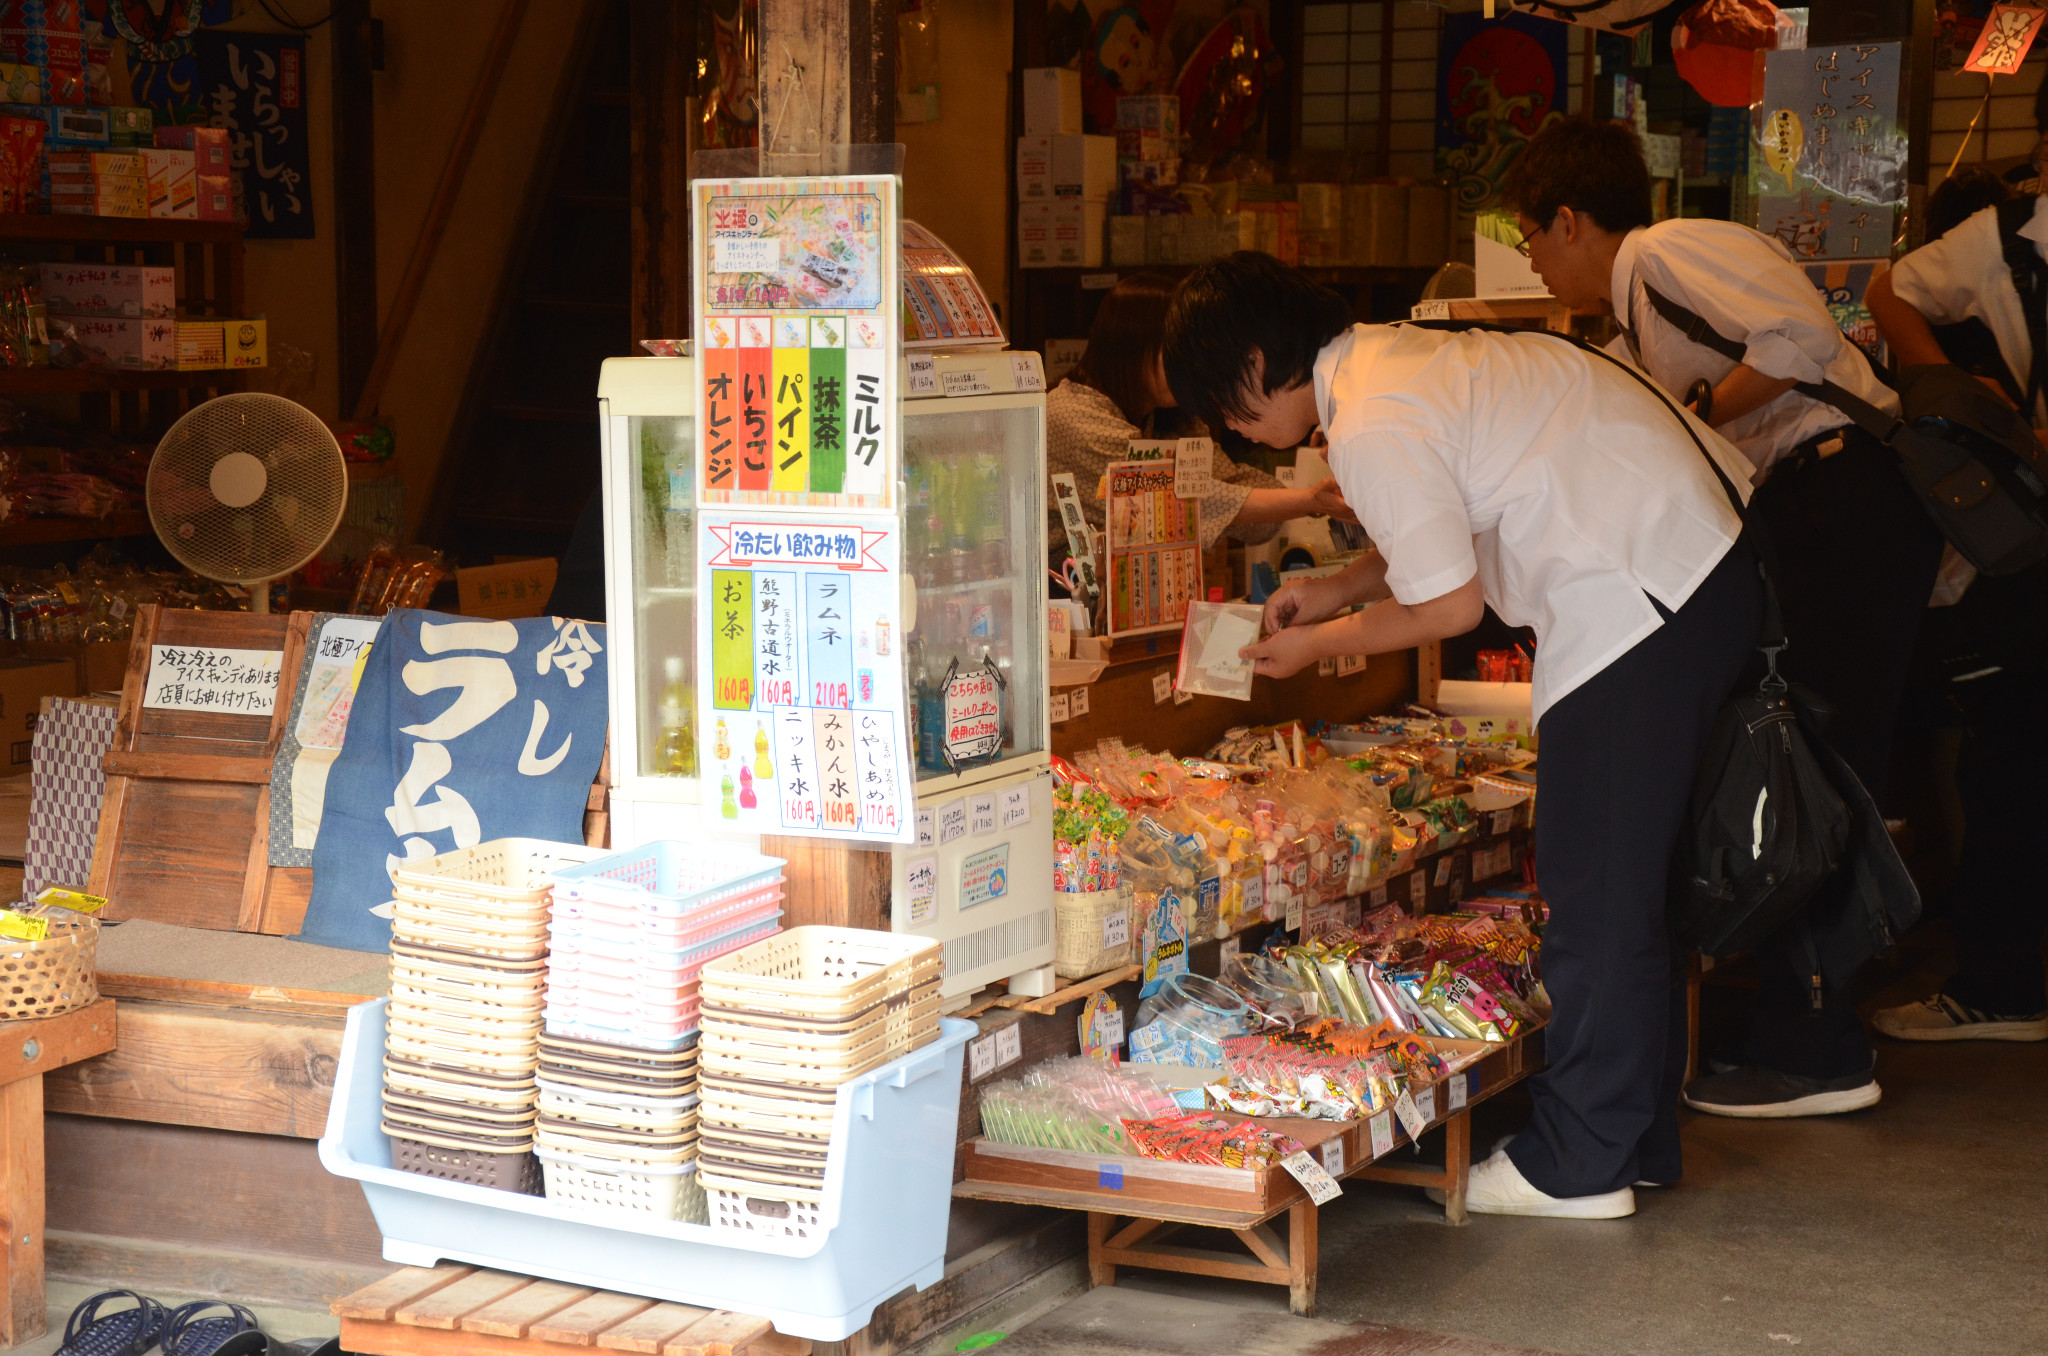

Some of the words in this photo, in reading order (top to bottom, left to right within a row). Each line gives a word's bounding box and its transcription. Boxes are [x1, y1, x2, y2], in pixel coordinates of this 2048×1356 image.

[716, 286, 747, 303] 各1本
[756, 286, 789, 303] 160円
[744, 373, 767, 471] いちご
[777, 373, 803, 472] パイン
[813, 376, 840, 450] 抹茶
[853, 374, 881, 467] ミルク
[708, 373, 732, 484] オレンジ
[734, 530, 857, 559] 冷たい飲み物
[720, 579, 745, 641] お茶
[817, 583, 842, 645] ラムネ
[759, 577, 783, 676] 熊野古道水
[158, 648, 232, 667] 冷え冷えの
[176, 664, 281, 690] アイスキャンディあります
[718, 676, 750, 704] 160円
[950, 678, 993, 698] こちらの店は
[154, 683, 273, 711] 店員にお申し付け下さい
[517, 615, 603, 776] 冷し
[761, 679, 792, 706] 160円
[815, 681, 848, 709] 210円
[950, 720, 998, 742] 使用はできません
[785, 711, 810, 796] ニッキ水
[823, 713, 850, 799] みかん水
[860, 716, 885, 801] ひやしあめ
[786, 799, 815, 822] 160円
[825, 801, 855, 826] 160円
[866, 804, 896, 828] 170円
